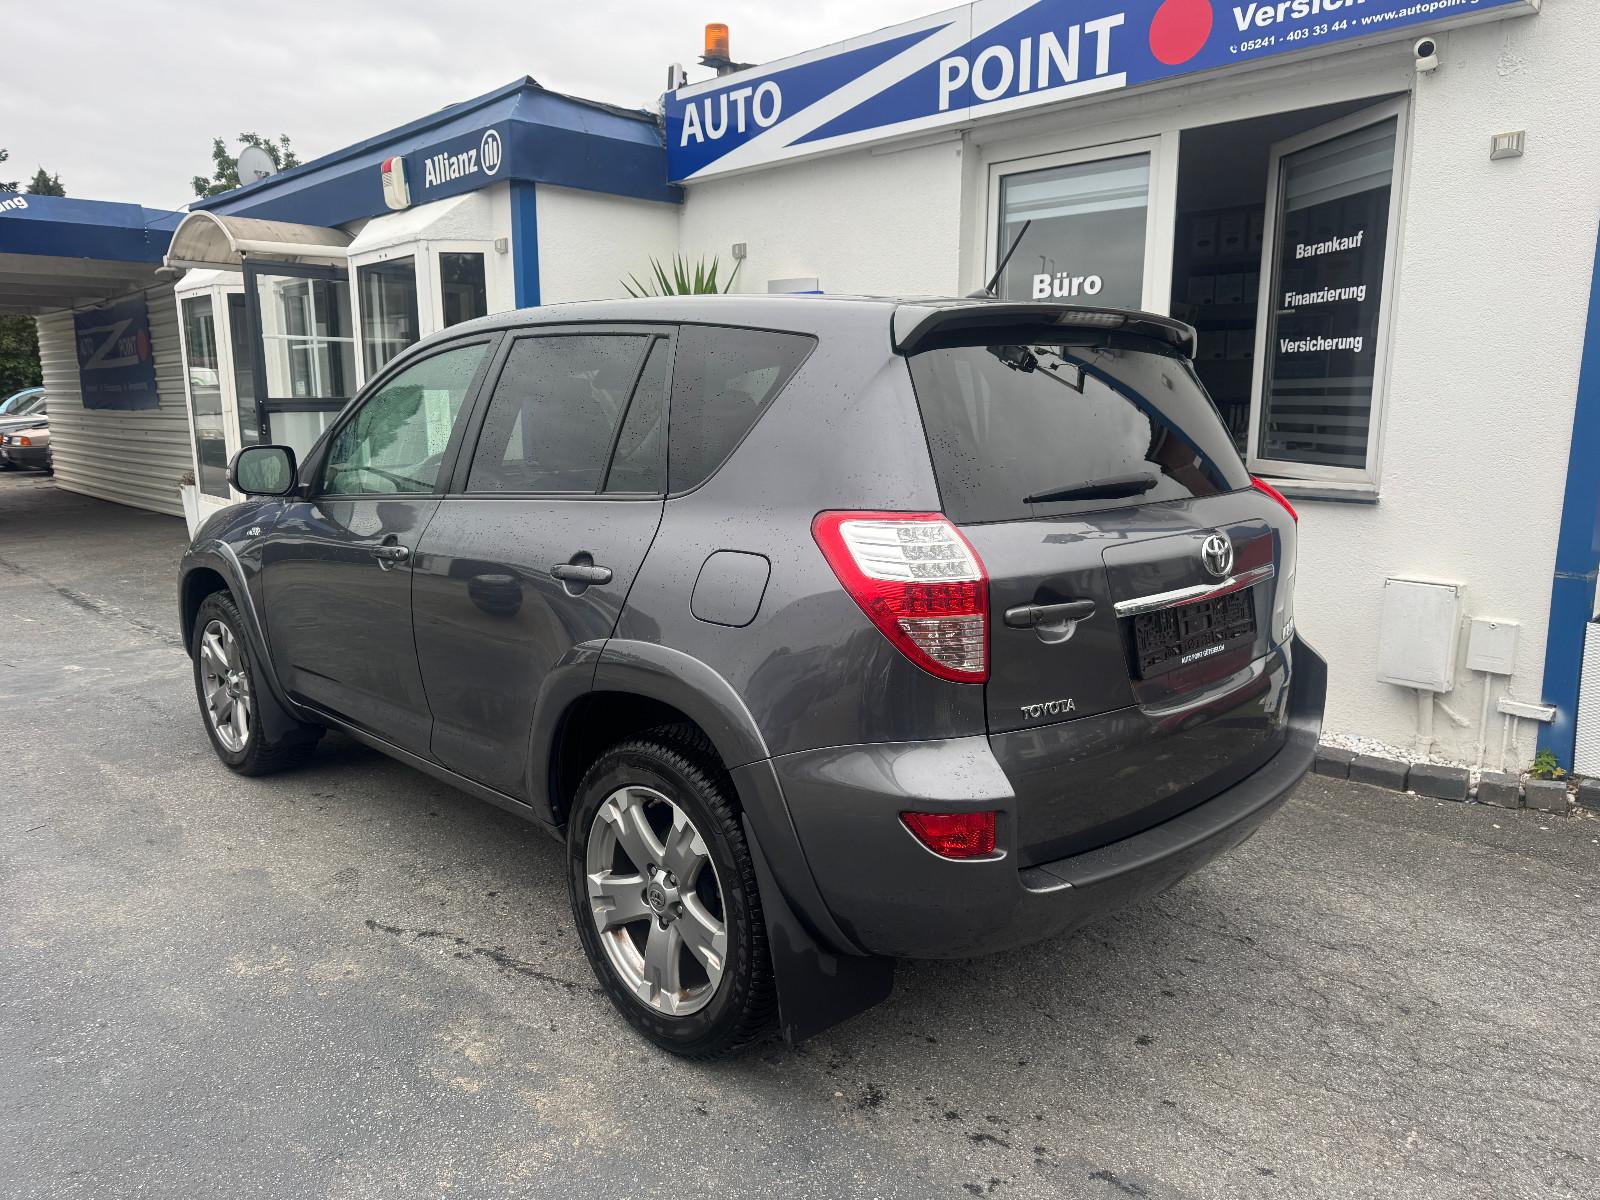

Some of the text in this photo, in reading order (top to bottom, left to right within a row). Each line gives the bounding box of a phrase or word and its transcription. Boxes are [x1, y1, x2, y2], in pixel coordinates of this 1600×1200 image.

[1232, 0, 1366, 31] Versic
[1240, 35, 1275, 51] 05241
[1286, 28, 1309, 41] 403
[1312, 24, 1328, 36] 33
[1331, 19, 1347, 32] 44
[680, 12, 1125, 147] AUTO POINT
[425, 148, 478, 188] Allianz
[1295, 230, 1364, 259] Barankauf
[1032, 272, 1102, 299] Büro
[1284, 284, 1367, 307] Finanzierung
[1280, 335, 1363, 353] Versicherung
[1020, 698, 1076, 719] TOYOTA
